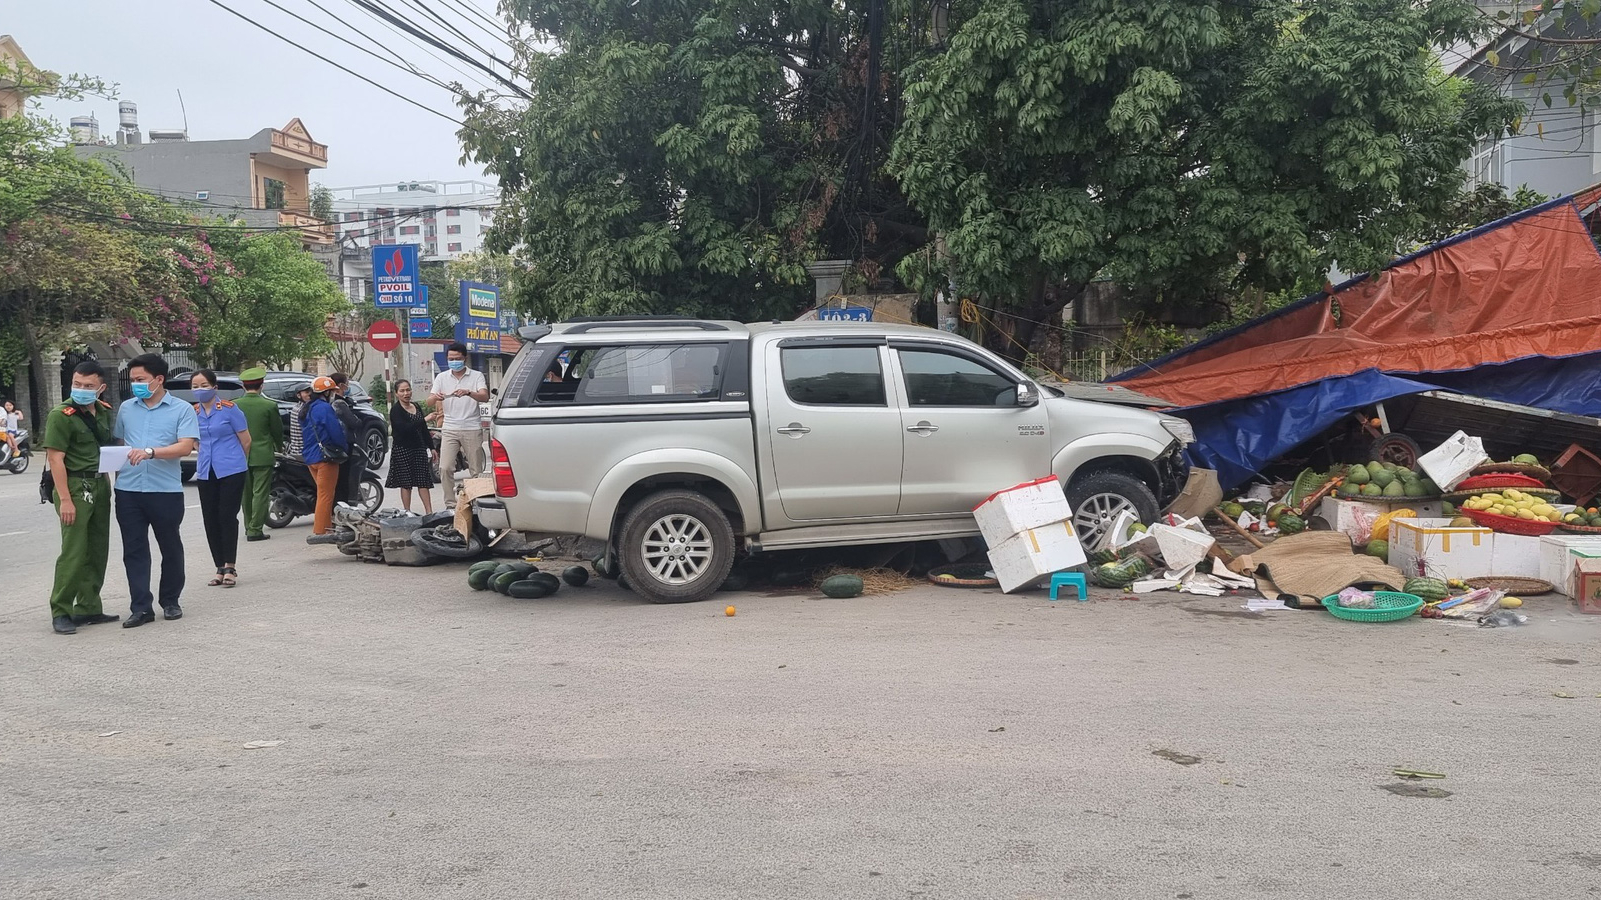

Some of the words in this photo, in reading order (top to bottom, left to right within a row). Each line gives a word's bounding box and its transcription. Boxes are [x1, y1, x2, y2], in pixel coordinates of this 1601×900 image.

[404, 295, 413, 303] 10
[471, 293, 495, 308] Modena
[467, 327, 480, 339] PHÚ
[489, 331, 499, 340] AN
